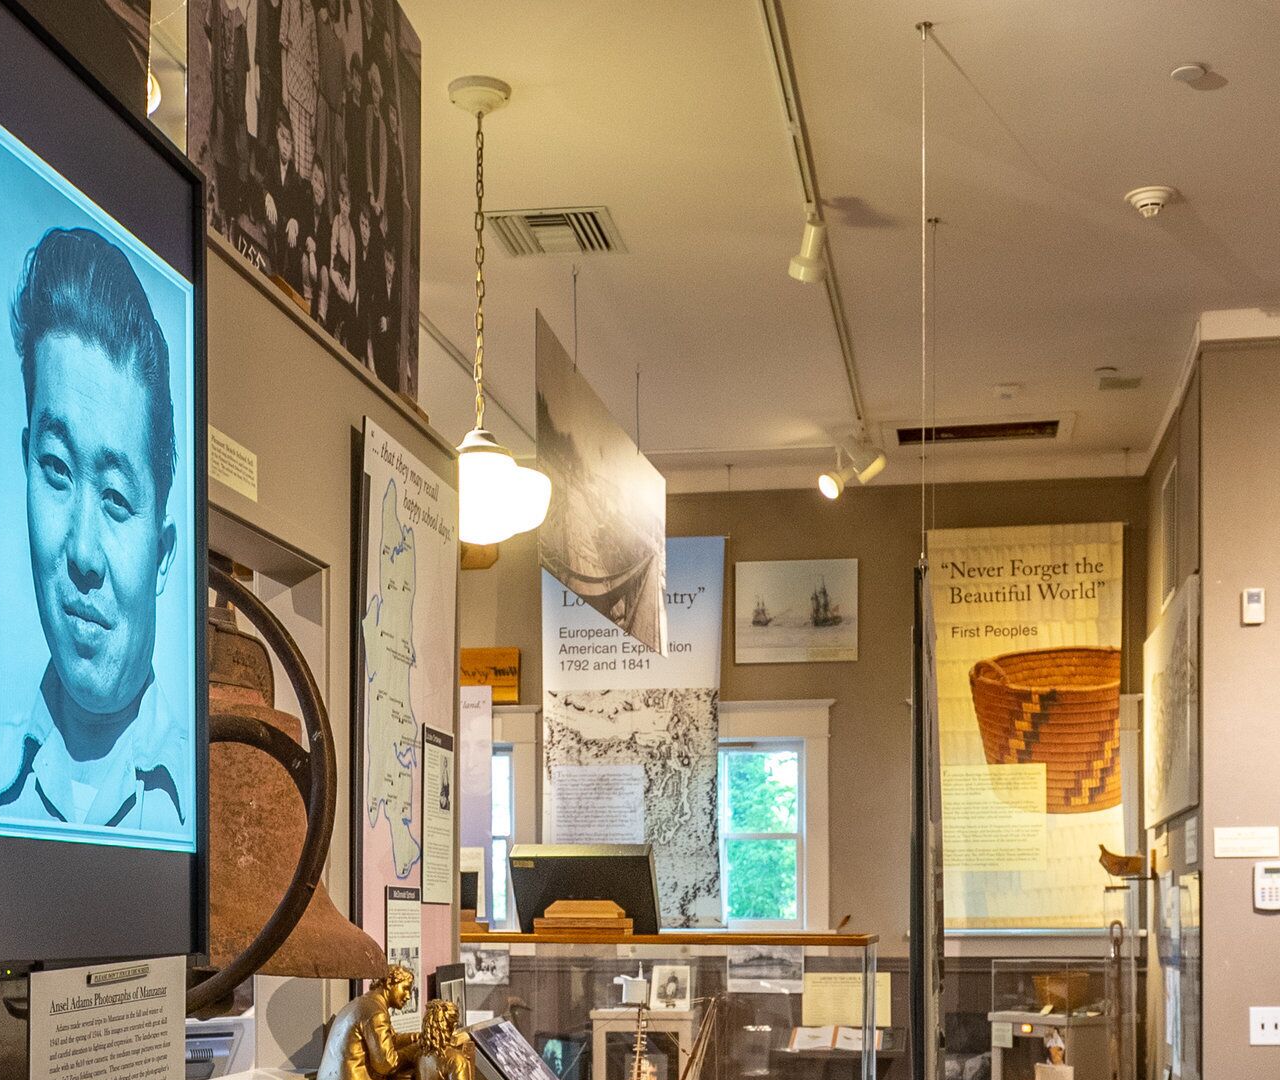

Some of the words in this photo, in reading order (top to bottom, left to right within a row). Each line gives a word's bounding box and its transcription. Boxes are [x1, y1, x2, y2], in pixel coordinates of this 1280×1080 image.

[380, 441, 396, 466] that
[395, 453, 409, 484] they
[410, 469, 423, 495] may
[423, 482, 439, 502] recall
[403, 488, 422, 525] happy
[421, 506, 440, 532] school
[941, 561, 1004, 579] “Never
[1010, 559, 1068, 582] Forget
[1075, 557, 1104, 574] the
[950, 584, 1033, 605] Beautiful
[1037, 581, 1105, 601] World”
[559, 627, 619, 640] European
[951, 626, 980, 639] First
[984, 625, 1038, 639] Peoples
[558, 642, 617, 655] American
[559, 660, 589, 671] 1792
[593, 659, 616, 671] and
[622, 658, 651, 670] 1841
[49, 997, 68, 1013] Ansel
[69, 993, 93, 1009] Adams
[93, 987, 131, 1009] Photographs
[131, 986, 139, 999] of
[139, 982, 167, 998] Manzanar
